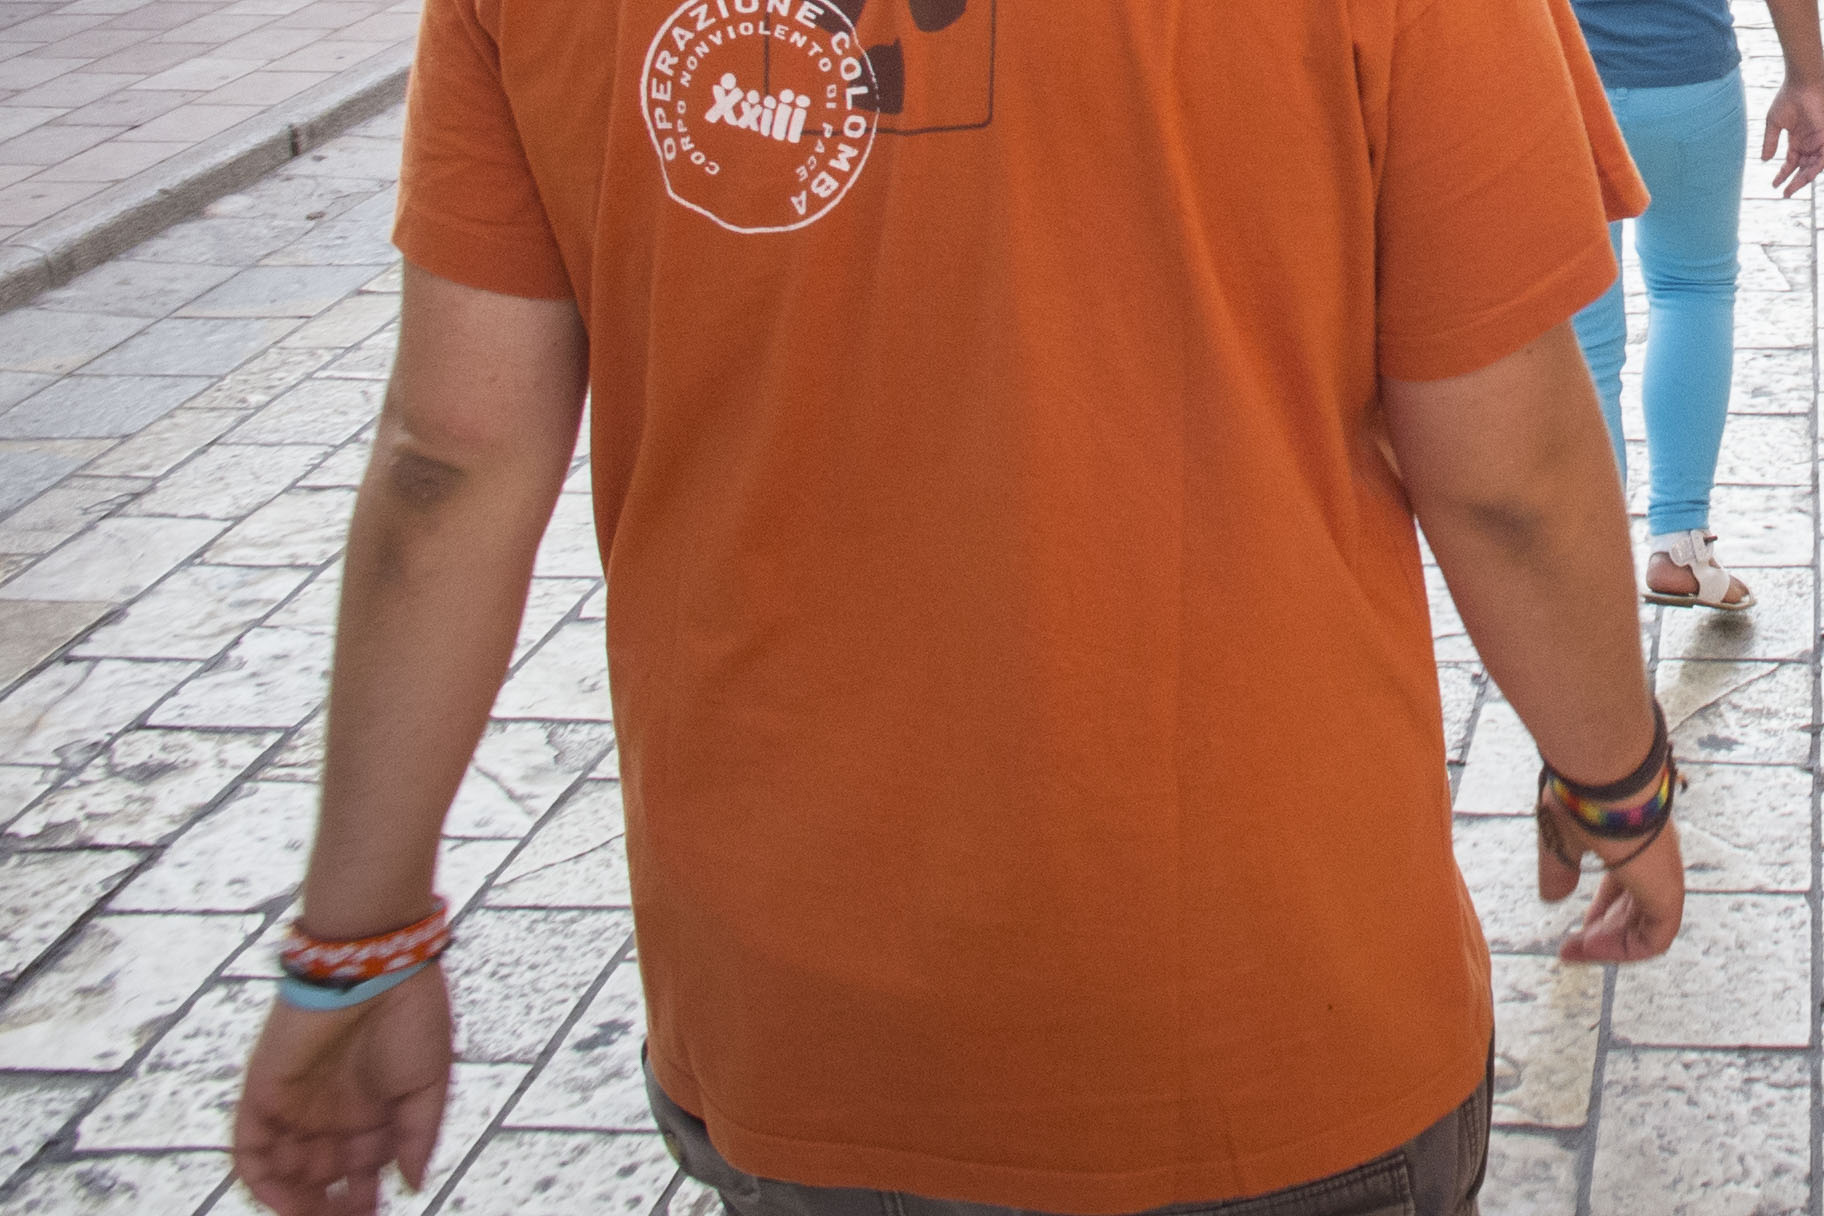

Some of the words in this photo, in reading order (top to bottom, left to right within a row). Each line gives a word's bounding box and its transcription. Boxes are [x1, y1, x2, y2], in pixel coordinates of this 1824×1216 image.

[790, 31, 869, 215] COLOMBA
[826, 84, 838, 109] DI
[677, 100, 720, 175] CORPO
[796, 122, 833, 182] PACE
